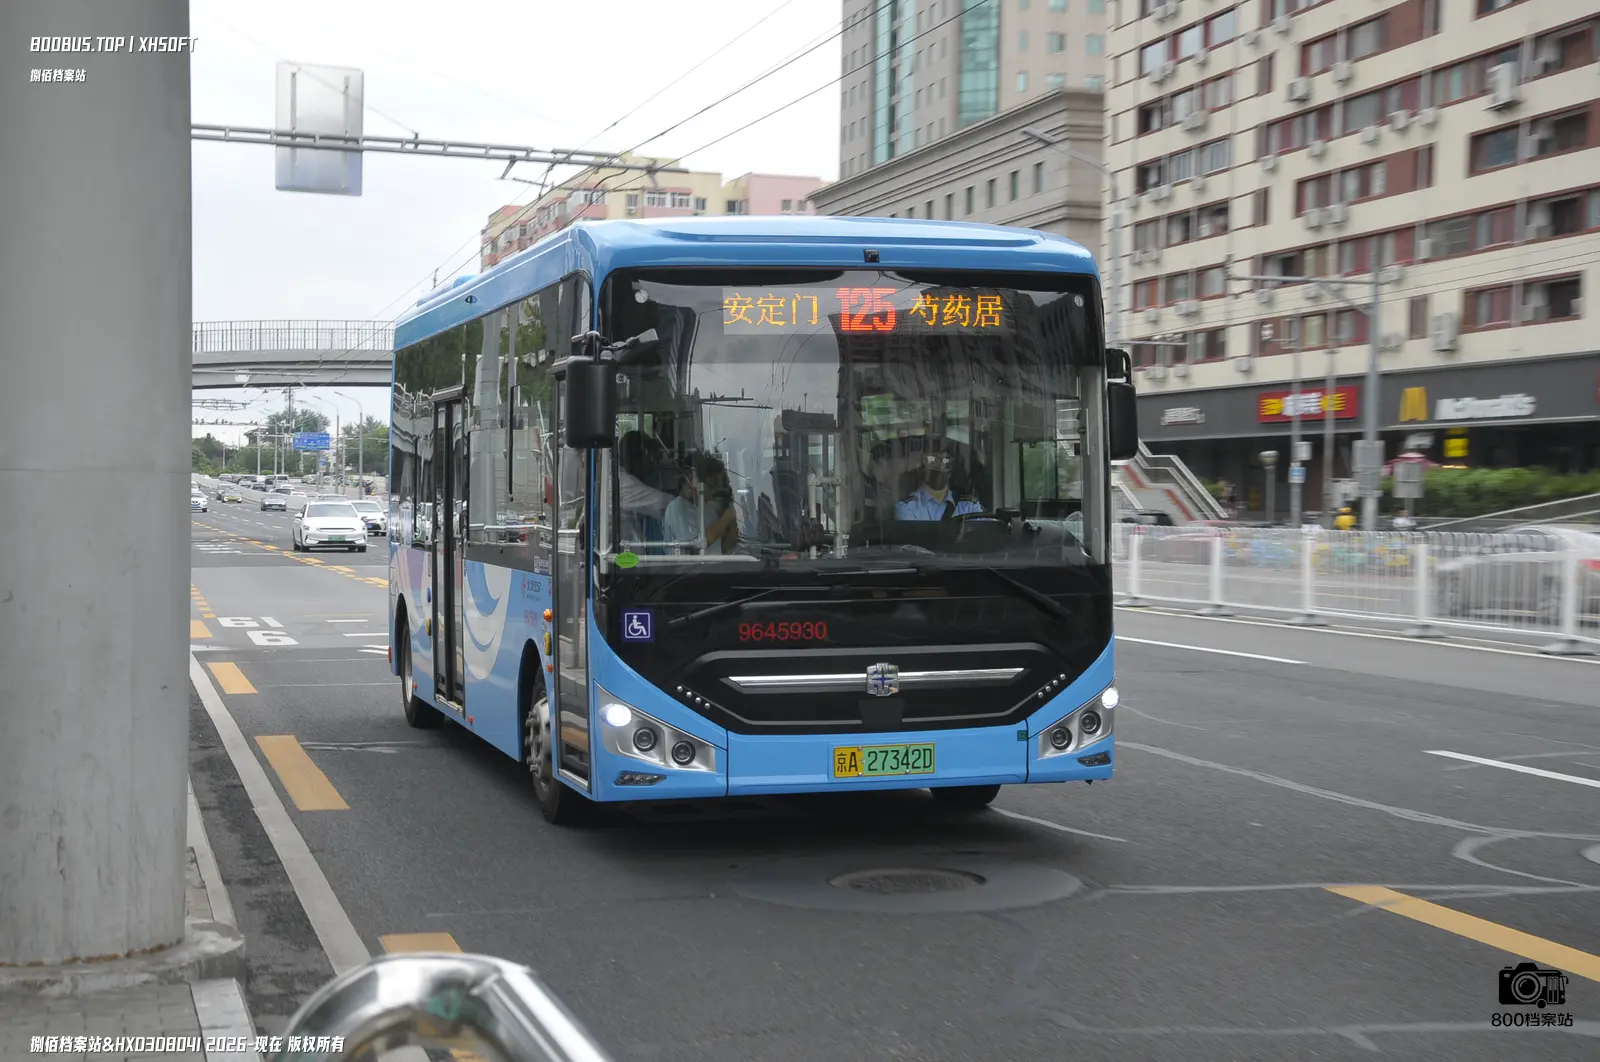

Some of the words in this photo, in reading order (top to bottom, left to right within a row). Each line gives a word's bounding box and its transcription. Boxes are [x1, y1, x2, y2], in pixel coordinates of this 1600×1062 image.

[723, 293, 818, 325] 安定门
[836, 288, 896, 331] 125
[909, 294, 1004, 327] 芍药居
[738, 621, 828, 641] 9645930
[836, 752, 859, 773] 京A
[867, 748, 933, 772] 27342D
